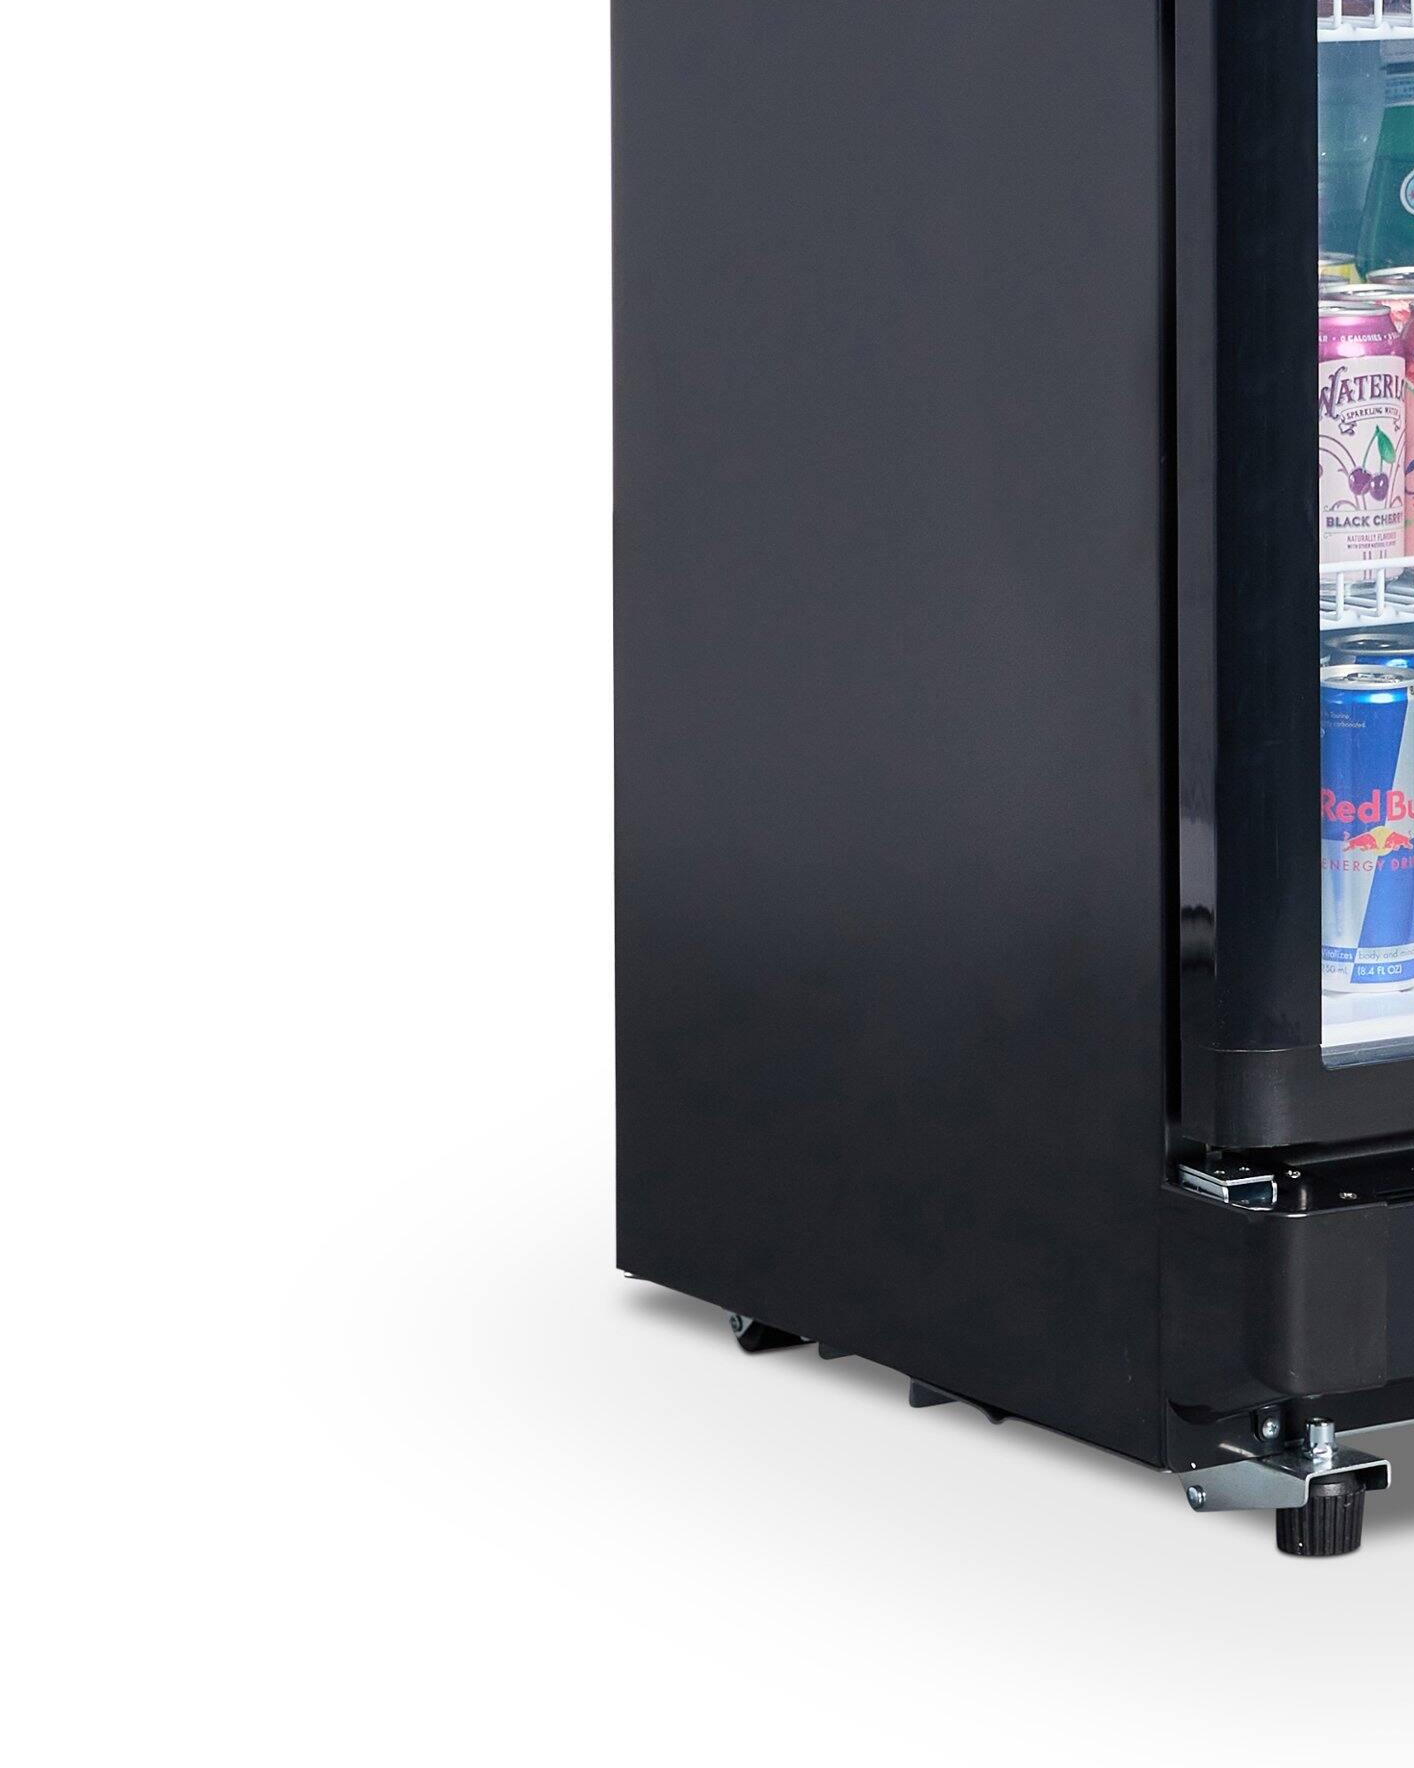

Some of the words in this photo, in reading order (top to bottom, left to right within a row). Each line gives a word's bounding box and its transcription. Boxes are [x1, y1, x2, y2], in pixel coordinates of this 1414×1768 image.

[1347, 408, 1382, 418] SPARKLING
[1326, 516, 1370, 527] BLACK
[1373, 514, 1402, 526] CHERR
[1321, 789, 1380, 823] Red
[1321, 858, 1385, 871] ENERGY
[1359, 953, 1379, 961] body
[1357, 966, 1374, 976] (8.4
[1377, 966, 1386, 974] FL
[1388, 965, 1402, 974] OZ)
